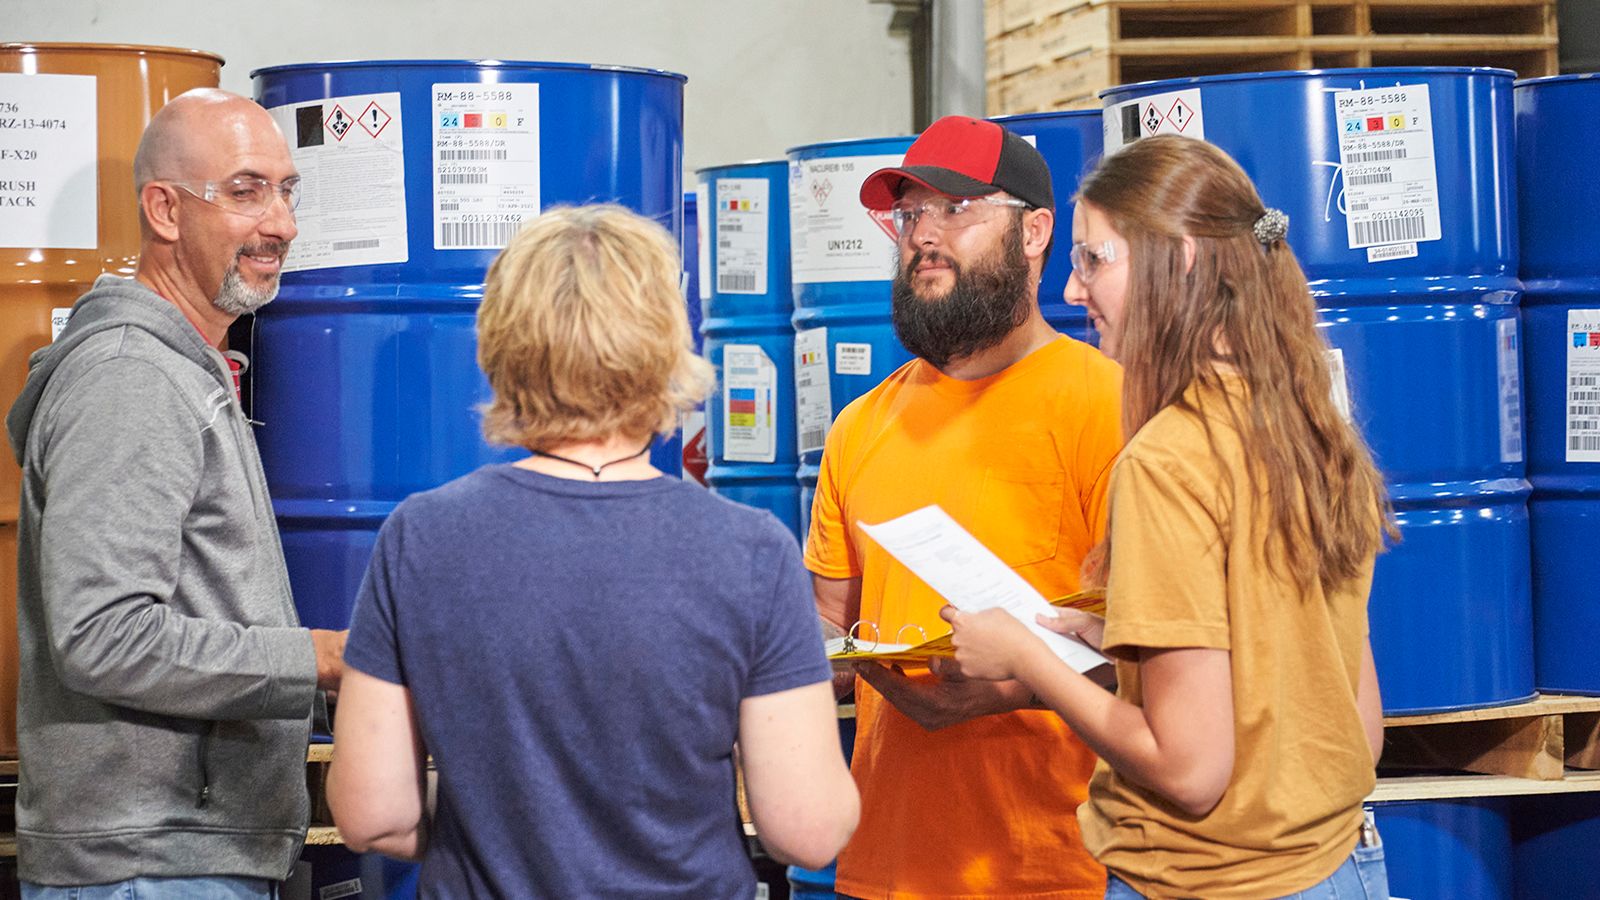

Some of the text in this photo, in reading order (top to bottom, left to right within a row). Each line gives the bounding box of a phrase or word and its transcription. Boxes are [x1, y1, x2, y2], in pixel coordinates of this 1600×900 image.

[437, 91, 512, 101] RM-88-5588
[1339, 93, 1407, 108] RM-88-5588
[443, 117, 458, 127] 24
[1346, 122, 1361, 131] 24
[437, 140, 506, 148] RM-88-5588/DR
[1342, 140, 1405, 152] RM-88-5588/DR
[828, 240, 863, 250] UN1212
